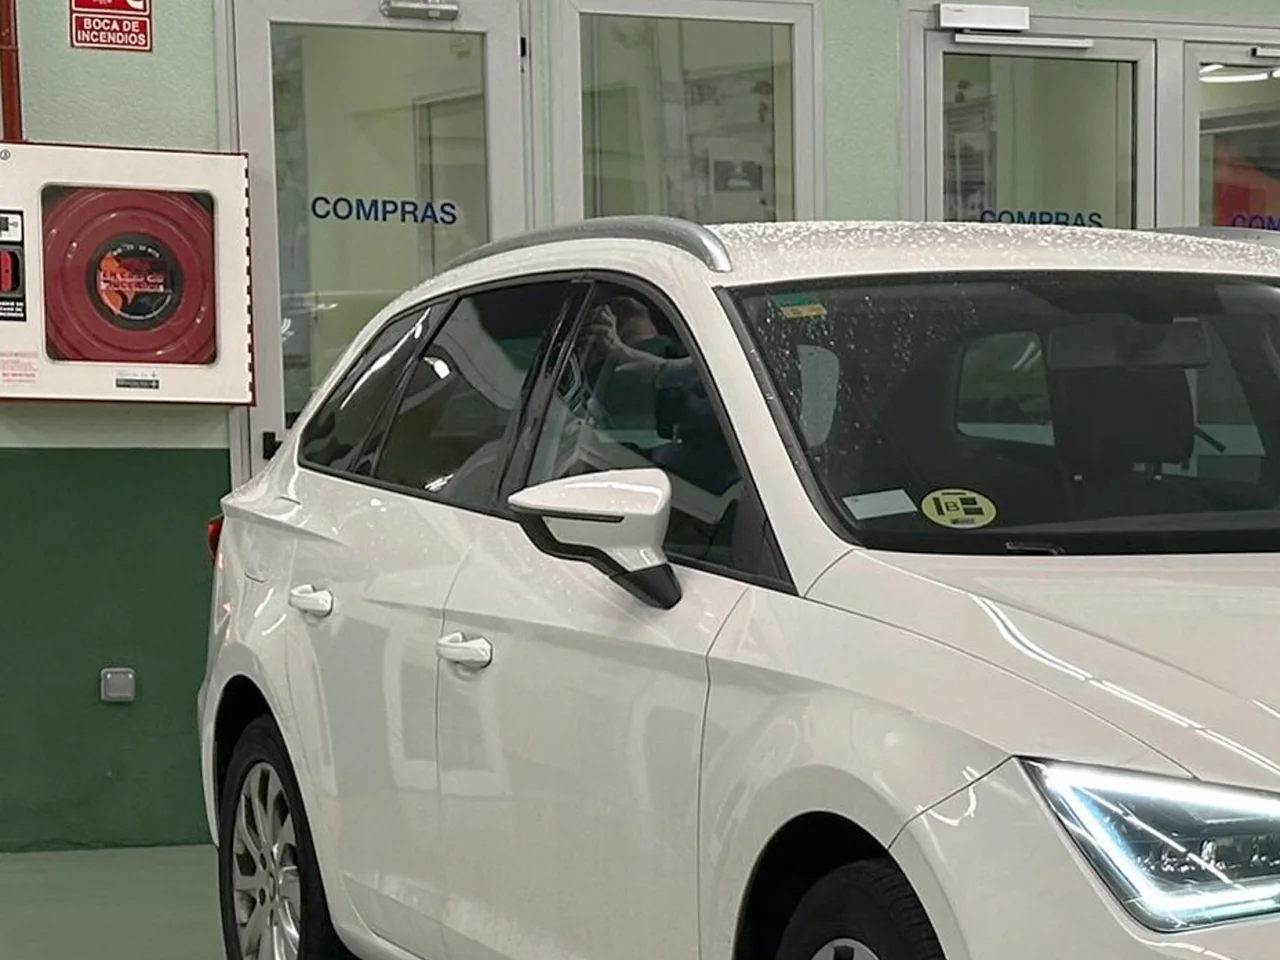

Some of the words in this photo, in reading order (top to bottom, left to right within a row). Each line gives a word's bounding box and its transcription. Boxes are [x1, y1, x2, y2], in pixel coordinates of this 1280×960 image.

[83, 18, 119, 31] BOCA
[122, 20, 140, 32] DE
[77, 30, 146, 46] INCENDIOS
[311, 196, 457, 225] COMPRAS
